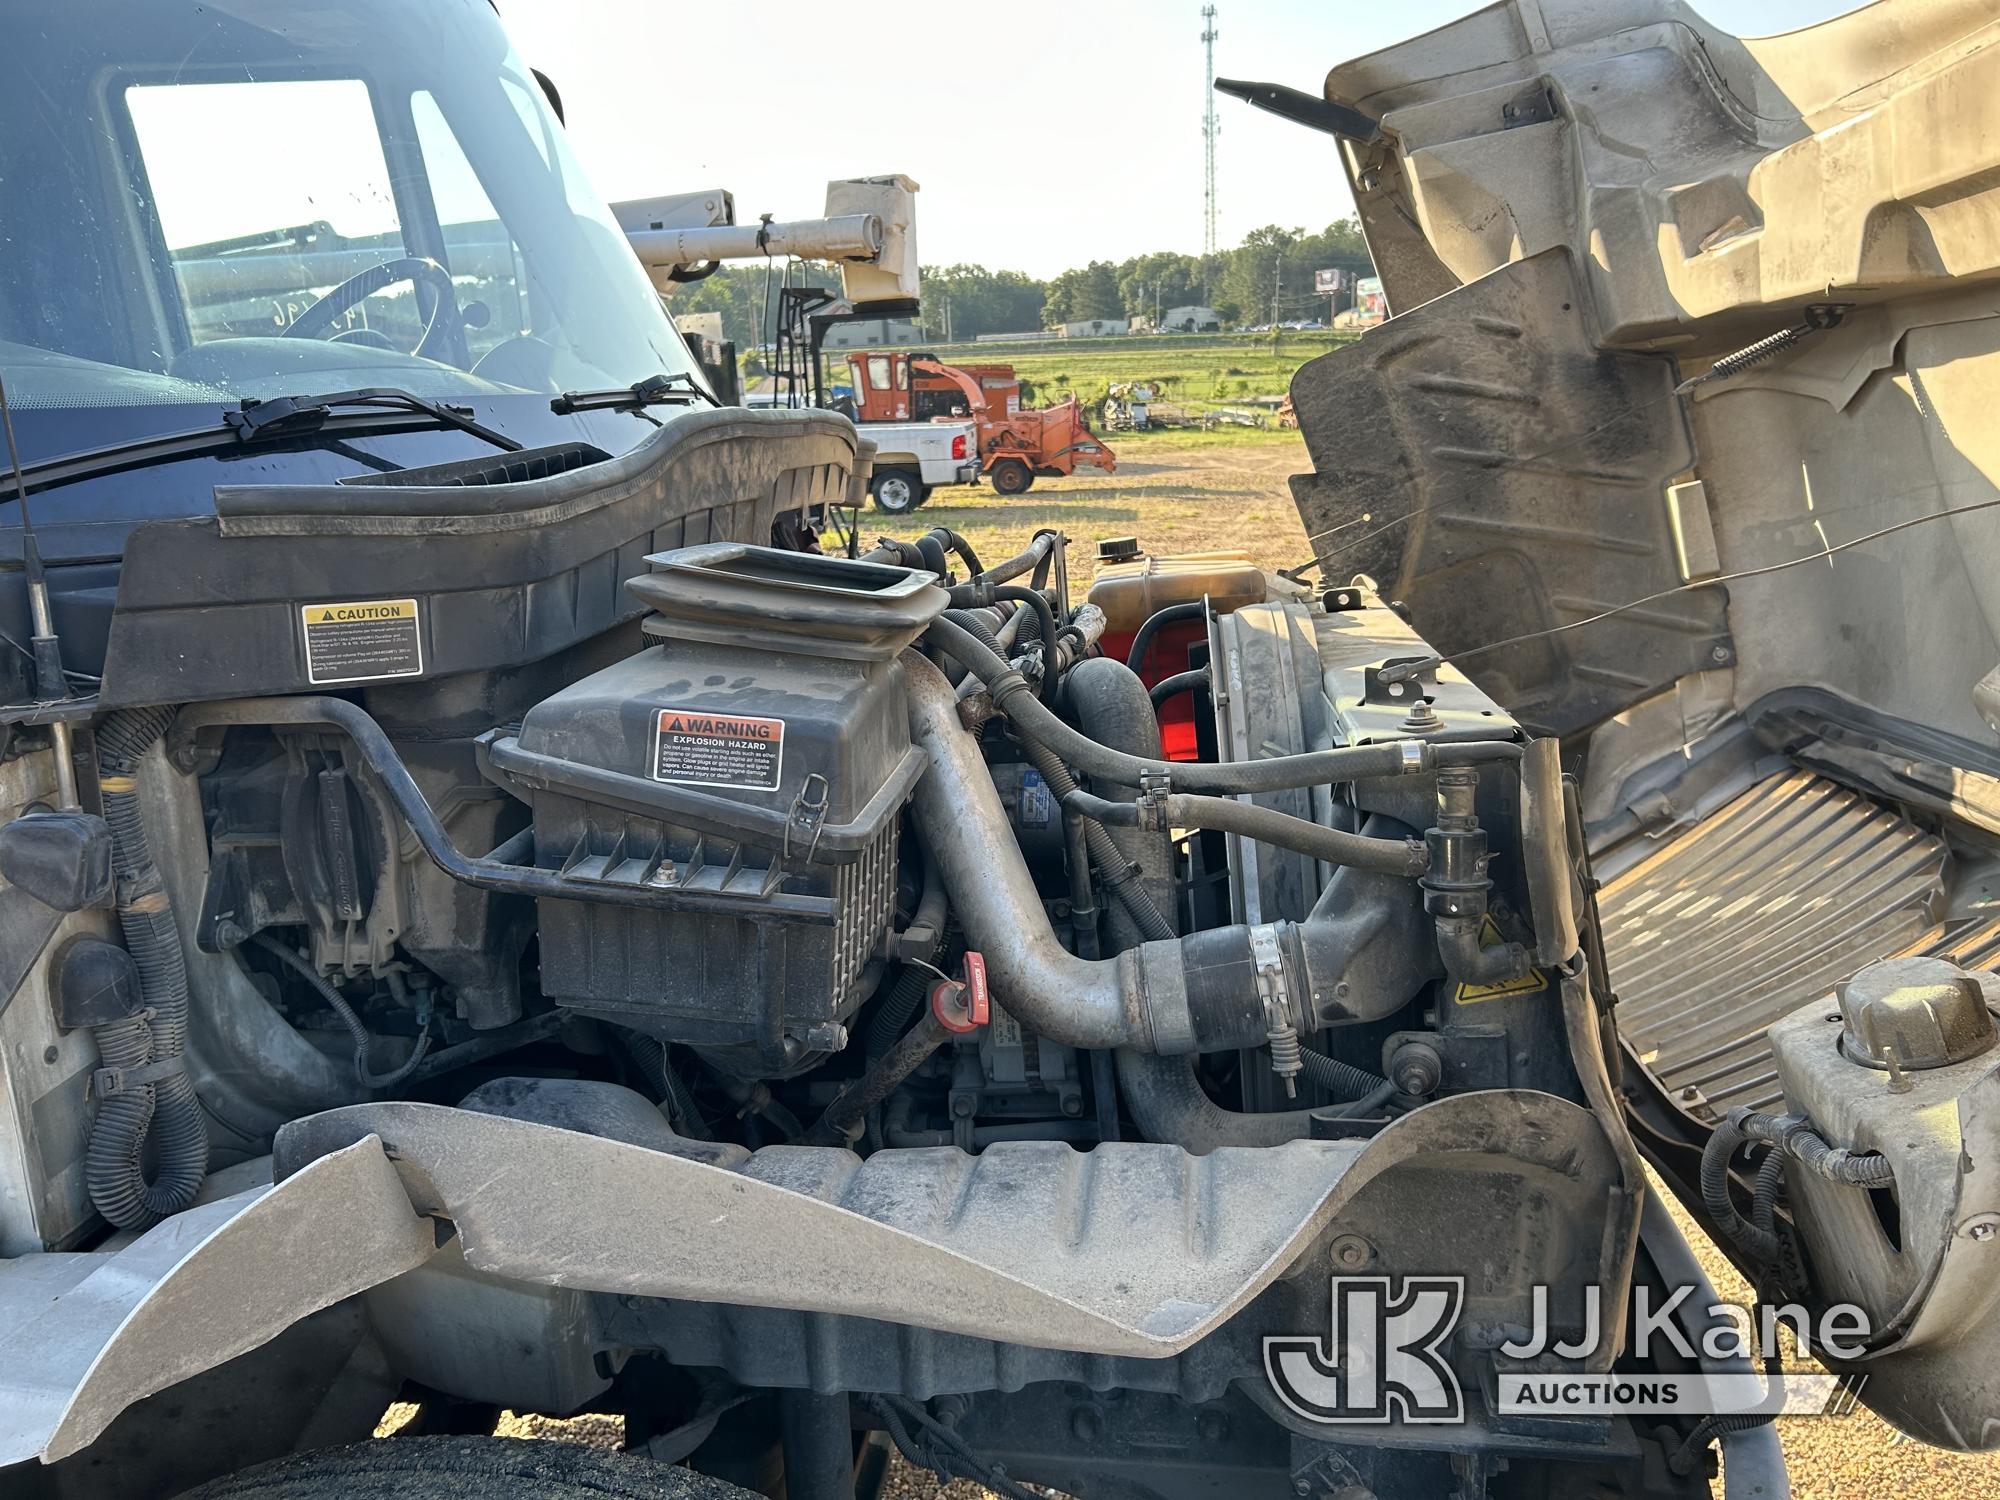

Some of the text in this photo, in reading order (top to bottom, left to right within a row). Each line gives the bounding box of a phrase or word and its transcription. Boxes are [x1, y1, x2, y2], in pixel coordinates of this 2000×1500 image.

[337, 607, 400, 620] CAUTION
[687, 719, 769, 738] WARNING
[673, 735, 766, 750] EXPLOSION HAZARD
[692, 752, 712, 760] gasoline
[746, 769, 767, 777] damage
